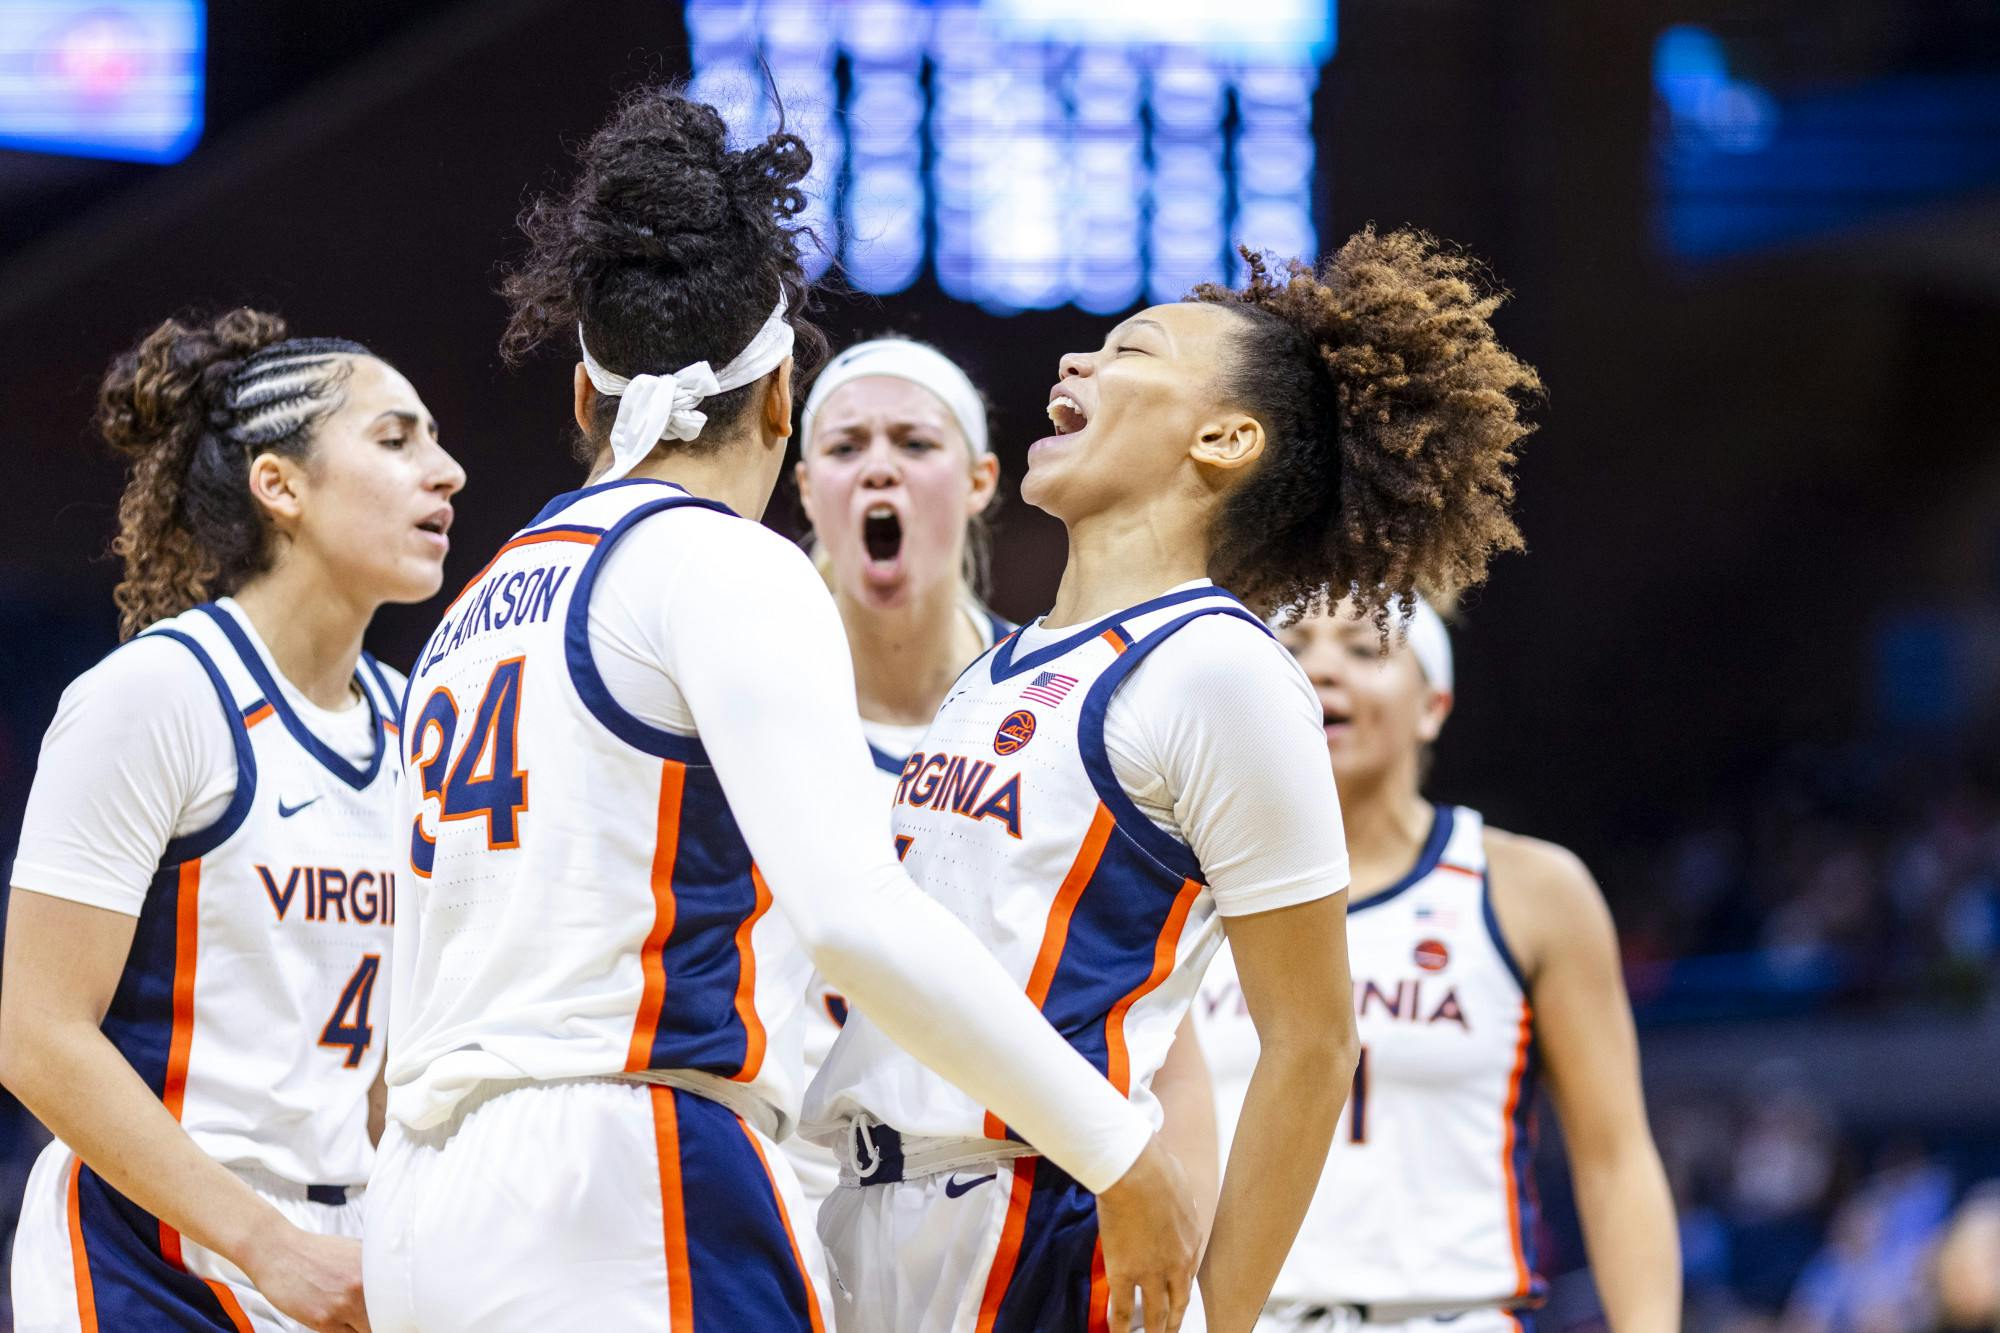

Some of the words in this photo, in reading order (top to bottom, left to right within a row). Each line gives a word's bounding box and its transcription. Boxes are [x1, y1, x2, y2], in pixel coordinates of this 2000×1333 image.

[410, 655, 528, 879] 34
[254, 864, 396, 926] VIRGI
[317, 953, 380, 1069] 4
